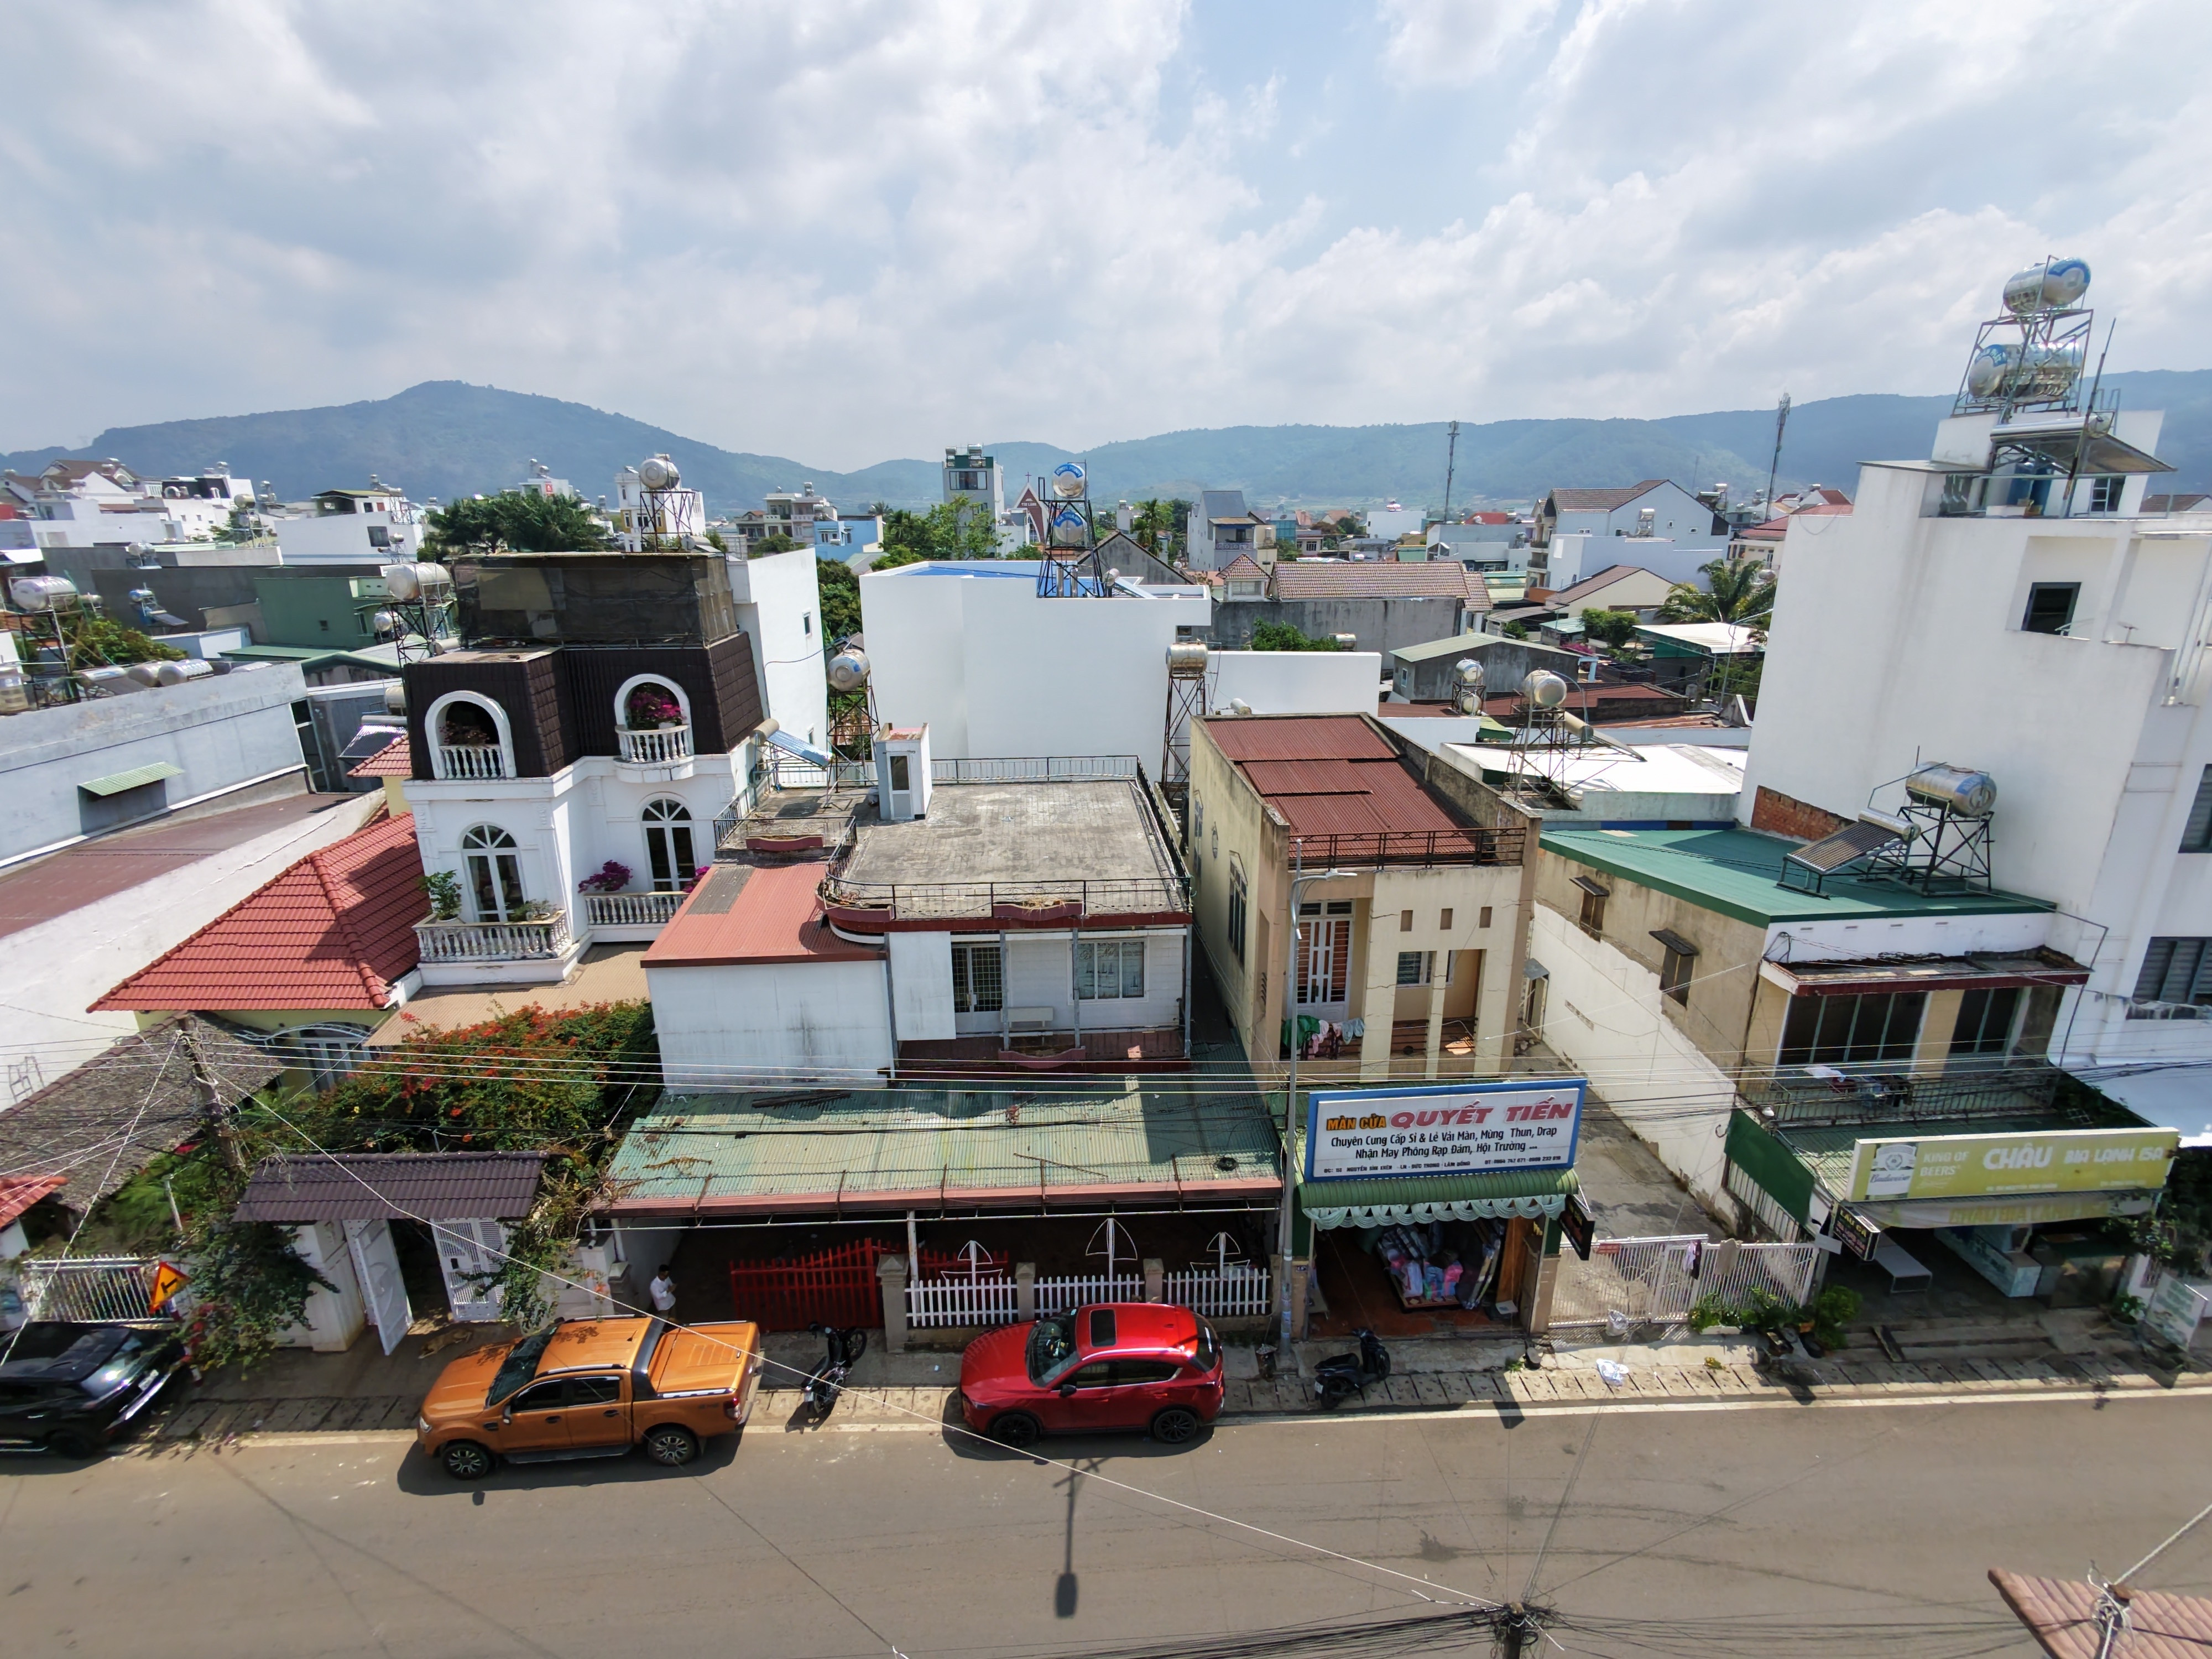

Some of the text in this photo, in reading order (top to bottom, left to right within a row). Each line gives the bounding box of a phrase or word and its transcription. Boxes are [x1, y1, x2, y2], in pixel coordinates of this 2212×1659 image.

[1359, 1113, 1387, 1130] CỬA
[1390, 1099, 1495, 1130] QUYẾT
[1505, 1095, 1574, 1123] TIẾN
[1331, 1136, 1363, 1148] Chuyên
[1365, 1135, 1387, 1146] Cung
[1390, 1132, 1406, 1145] Cấp
[1419, 1133, 1426, 1142] &
[1429, 1131, 1439, 1142] Lẻ
[1441, 1129, 1454, 1141] Vải
[1457, 1129, 1478, 1142] Màn,
[1480, 1129, 1504, 1140] Mùng
[1511, 1127, 1535, 1139] Thun,
[1537, 1126, 1557, 1138] Drap
[1355, 1149, 1378, 1160] Nhận
[1381, 1148, 1399, 1159] May
[1402, 1146, 1430, 1157] Phông
[1432, 1145, 1448, 1157] Rạp
[1451, 1144, 1473, 1155] Đám,
[1477, 1142, 1490, 1154] Hội
[1494, 1140, 1526, 1152] Trường
[1923, 1151, 1970, 1163] KING OF
[1983, 1142, 2053, 1170] CHÂU
[2064, 1149, 2090, 1165] BIA
[2093, 1147, 2136, 1166] LẠNH
[1920, 1165, 1957, 1177] BEERS
